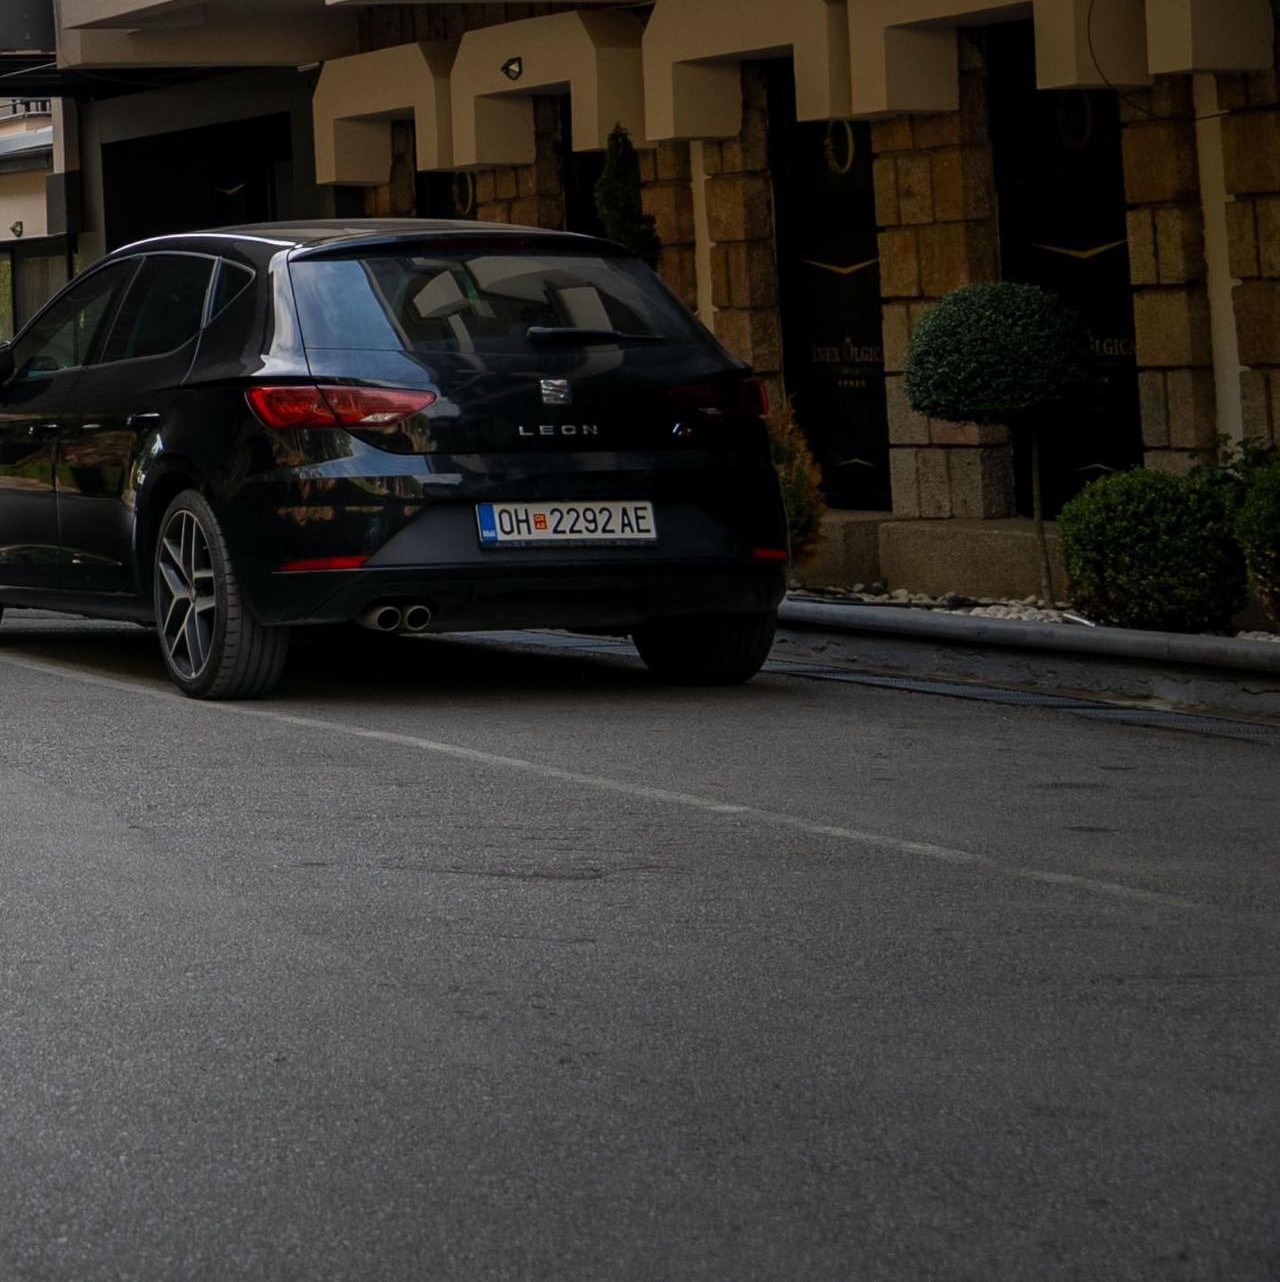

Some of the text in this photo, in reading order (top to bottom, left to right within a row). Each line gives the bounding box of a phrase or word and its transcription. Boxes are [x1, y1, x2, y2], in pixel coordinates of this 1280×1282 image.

[518, 424, 599, 437] LEON
[498, 508, 532, 536] OH
[549, 507, 616, 535] 2292
[620, 506, 652, 534] AE
